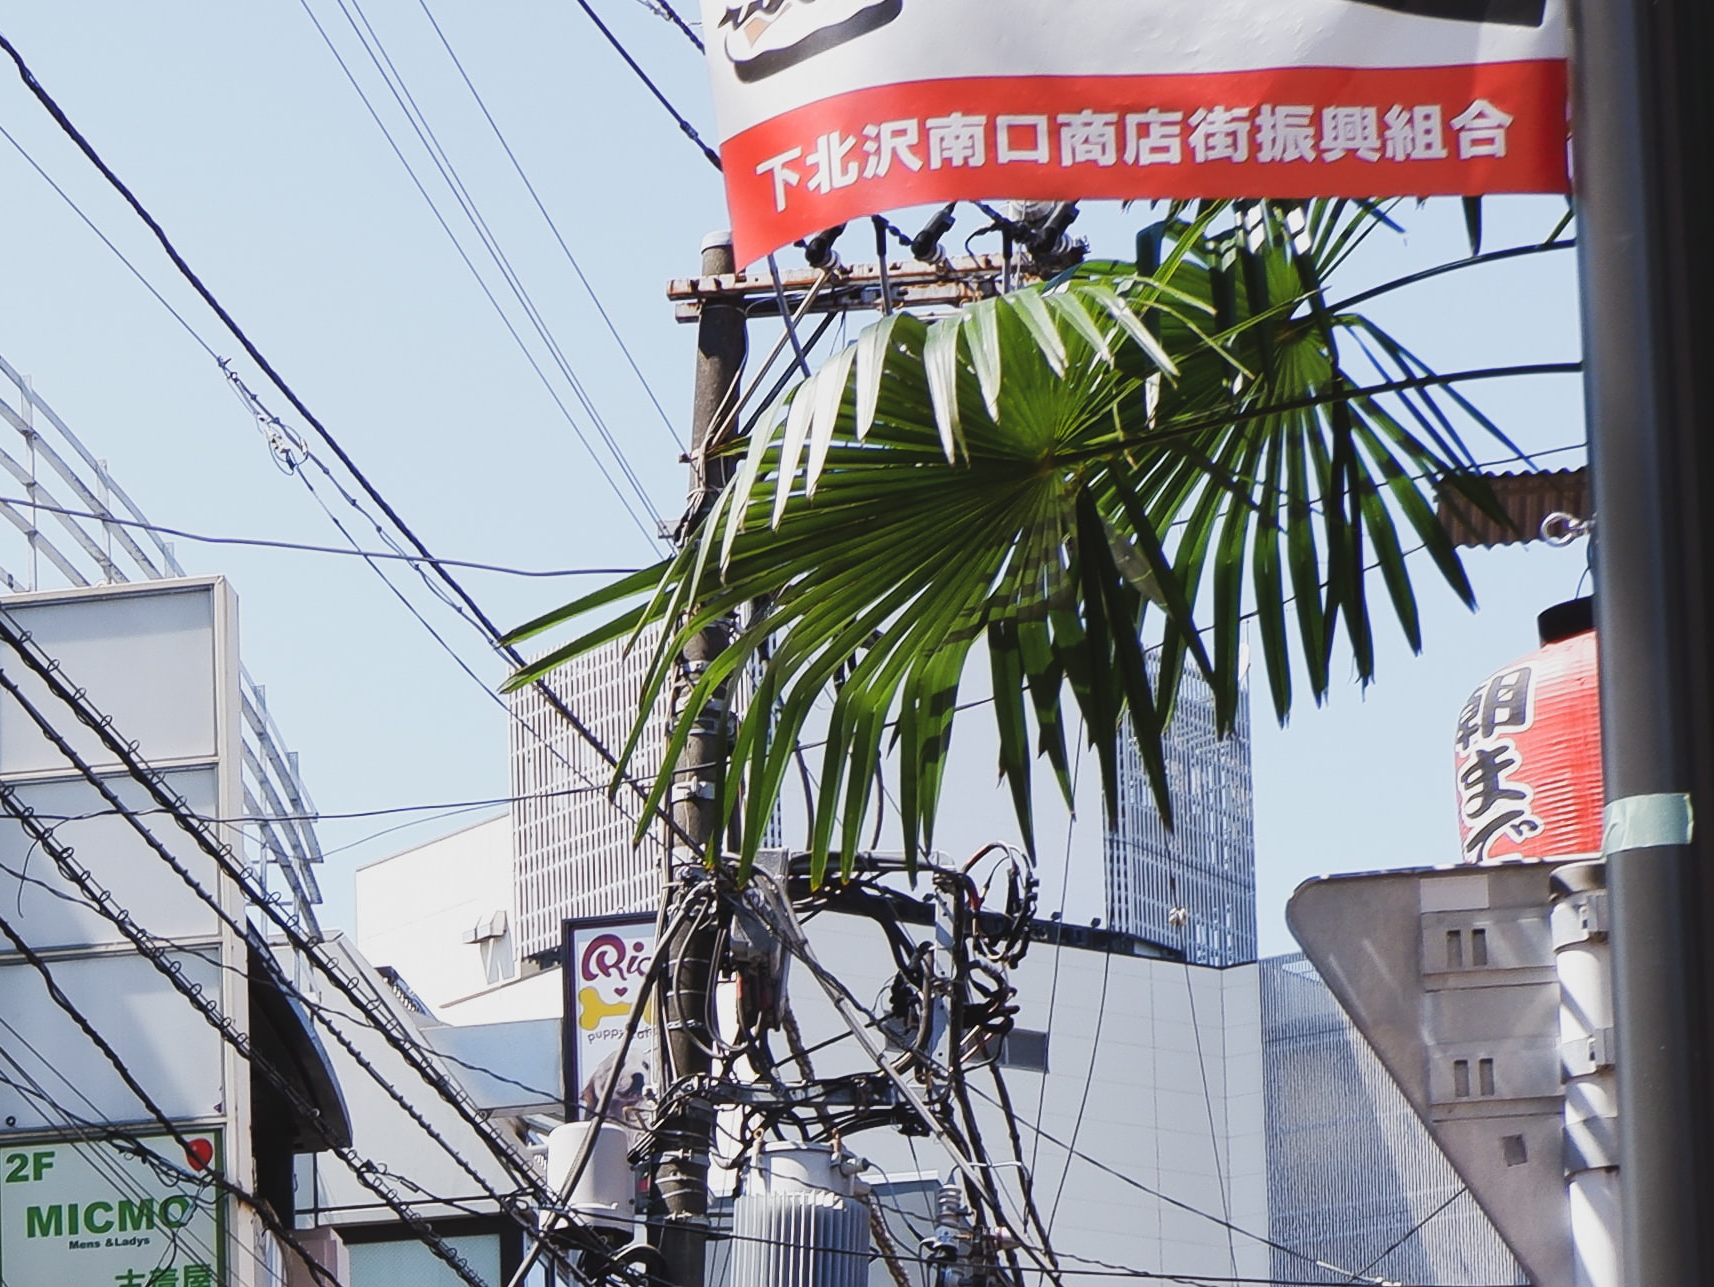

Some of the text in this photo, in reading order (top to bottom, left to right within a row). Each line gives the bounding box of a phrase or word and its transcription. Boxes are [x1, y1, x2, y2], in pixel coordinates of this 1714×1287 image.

[756, 98, 1515, 213] 下北沢南口商店街振興組合
[4, 1151, 55, 1184] 2F
[26, 1195, 193, 1239] MICMO
[68, 1238, 101, 1251] Mens
